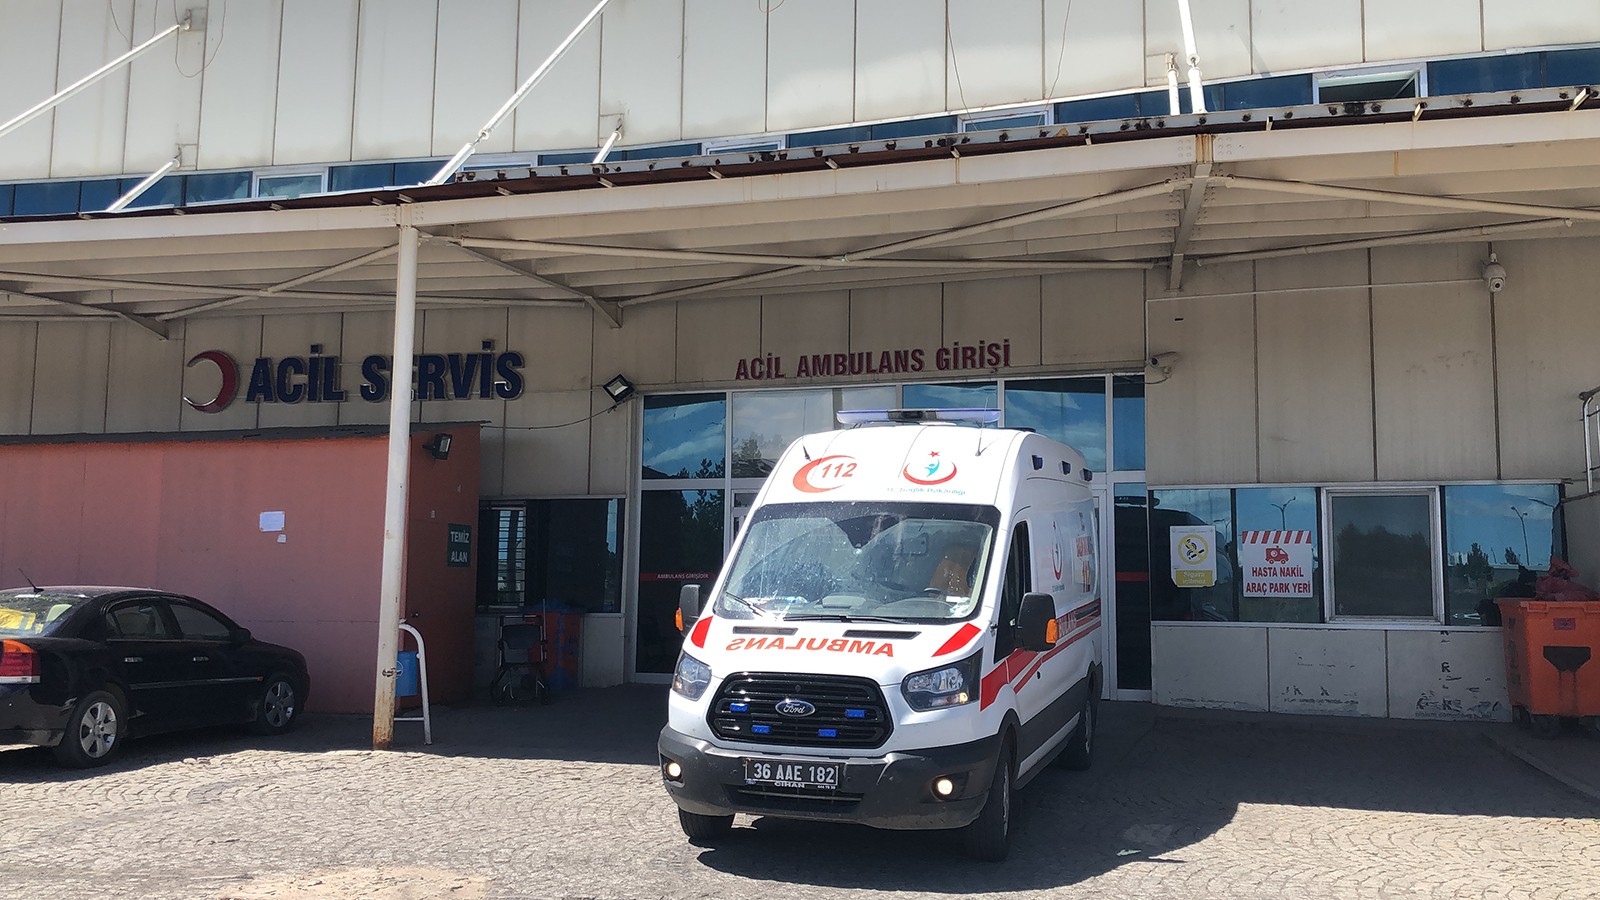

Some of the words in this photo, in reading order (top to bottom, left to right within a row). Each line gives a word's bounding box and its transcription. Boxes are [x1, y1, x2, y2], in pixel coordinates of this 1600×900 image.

[735, 352, 785, 380] ACİL
[796, 349, 925, 378] AMBULANS
[936, 339, 1011, 374] GİRİŞİ
[246, 344, 347, 403] ACİL
[360, 340, 526, 402] SRVİS
[821, 462, 858, 479] 112
[450, 529, 470, 544] TEMİZ
[450, 551, 468, 563] ALAN
[1251, 566, 1278, 578] HASTA
[1280, 564, 1304, 578] NAKİL
[1245, 583, 1268, 596] ARAÇ
[1269, 582, 1291, 594] PARK
[1292, 580, 1311, 593] YERİ
[783, 702, 806, 714] Ford
[753, 762, 771, 779] 36
[775, 764, 803, 781] AAE
[809, 766, 835, 783] 182
